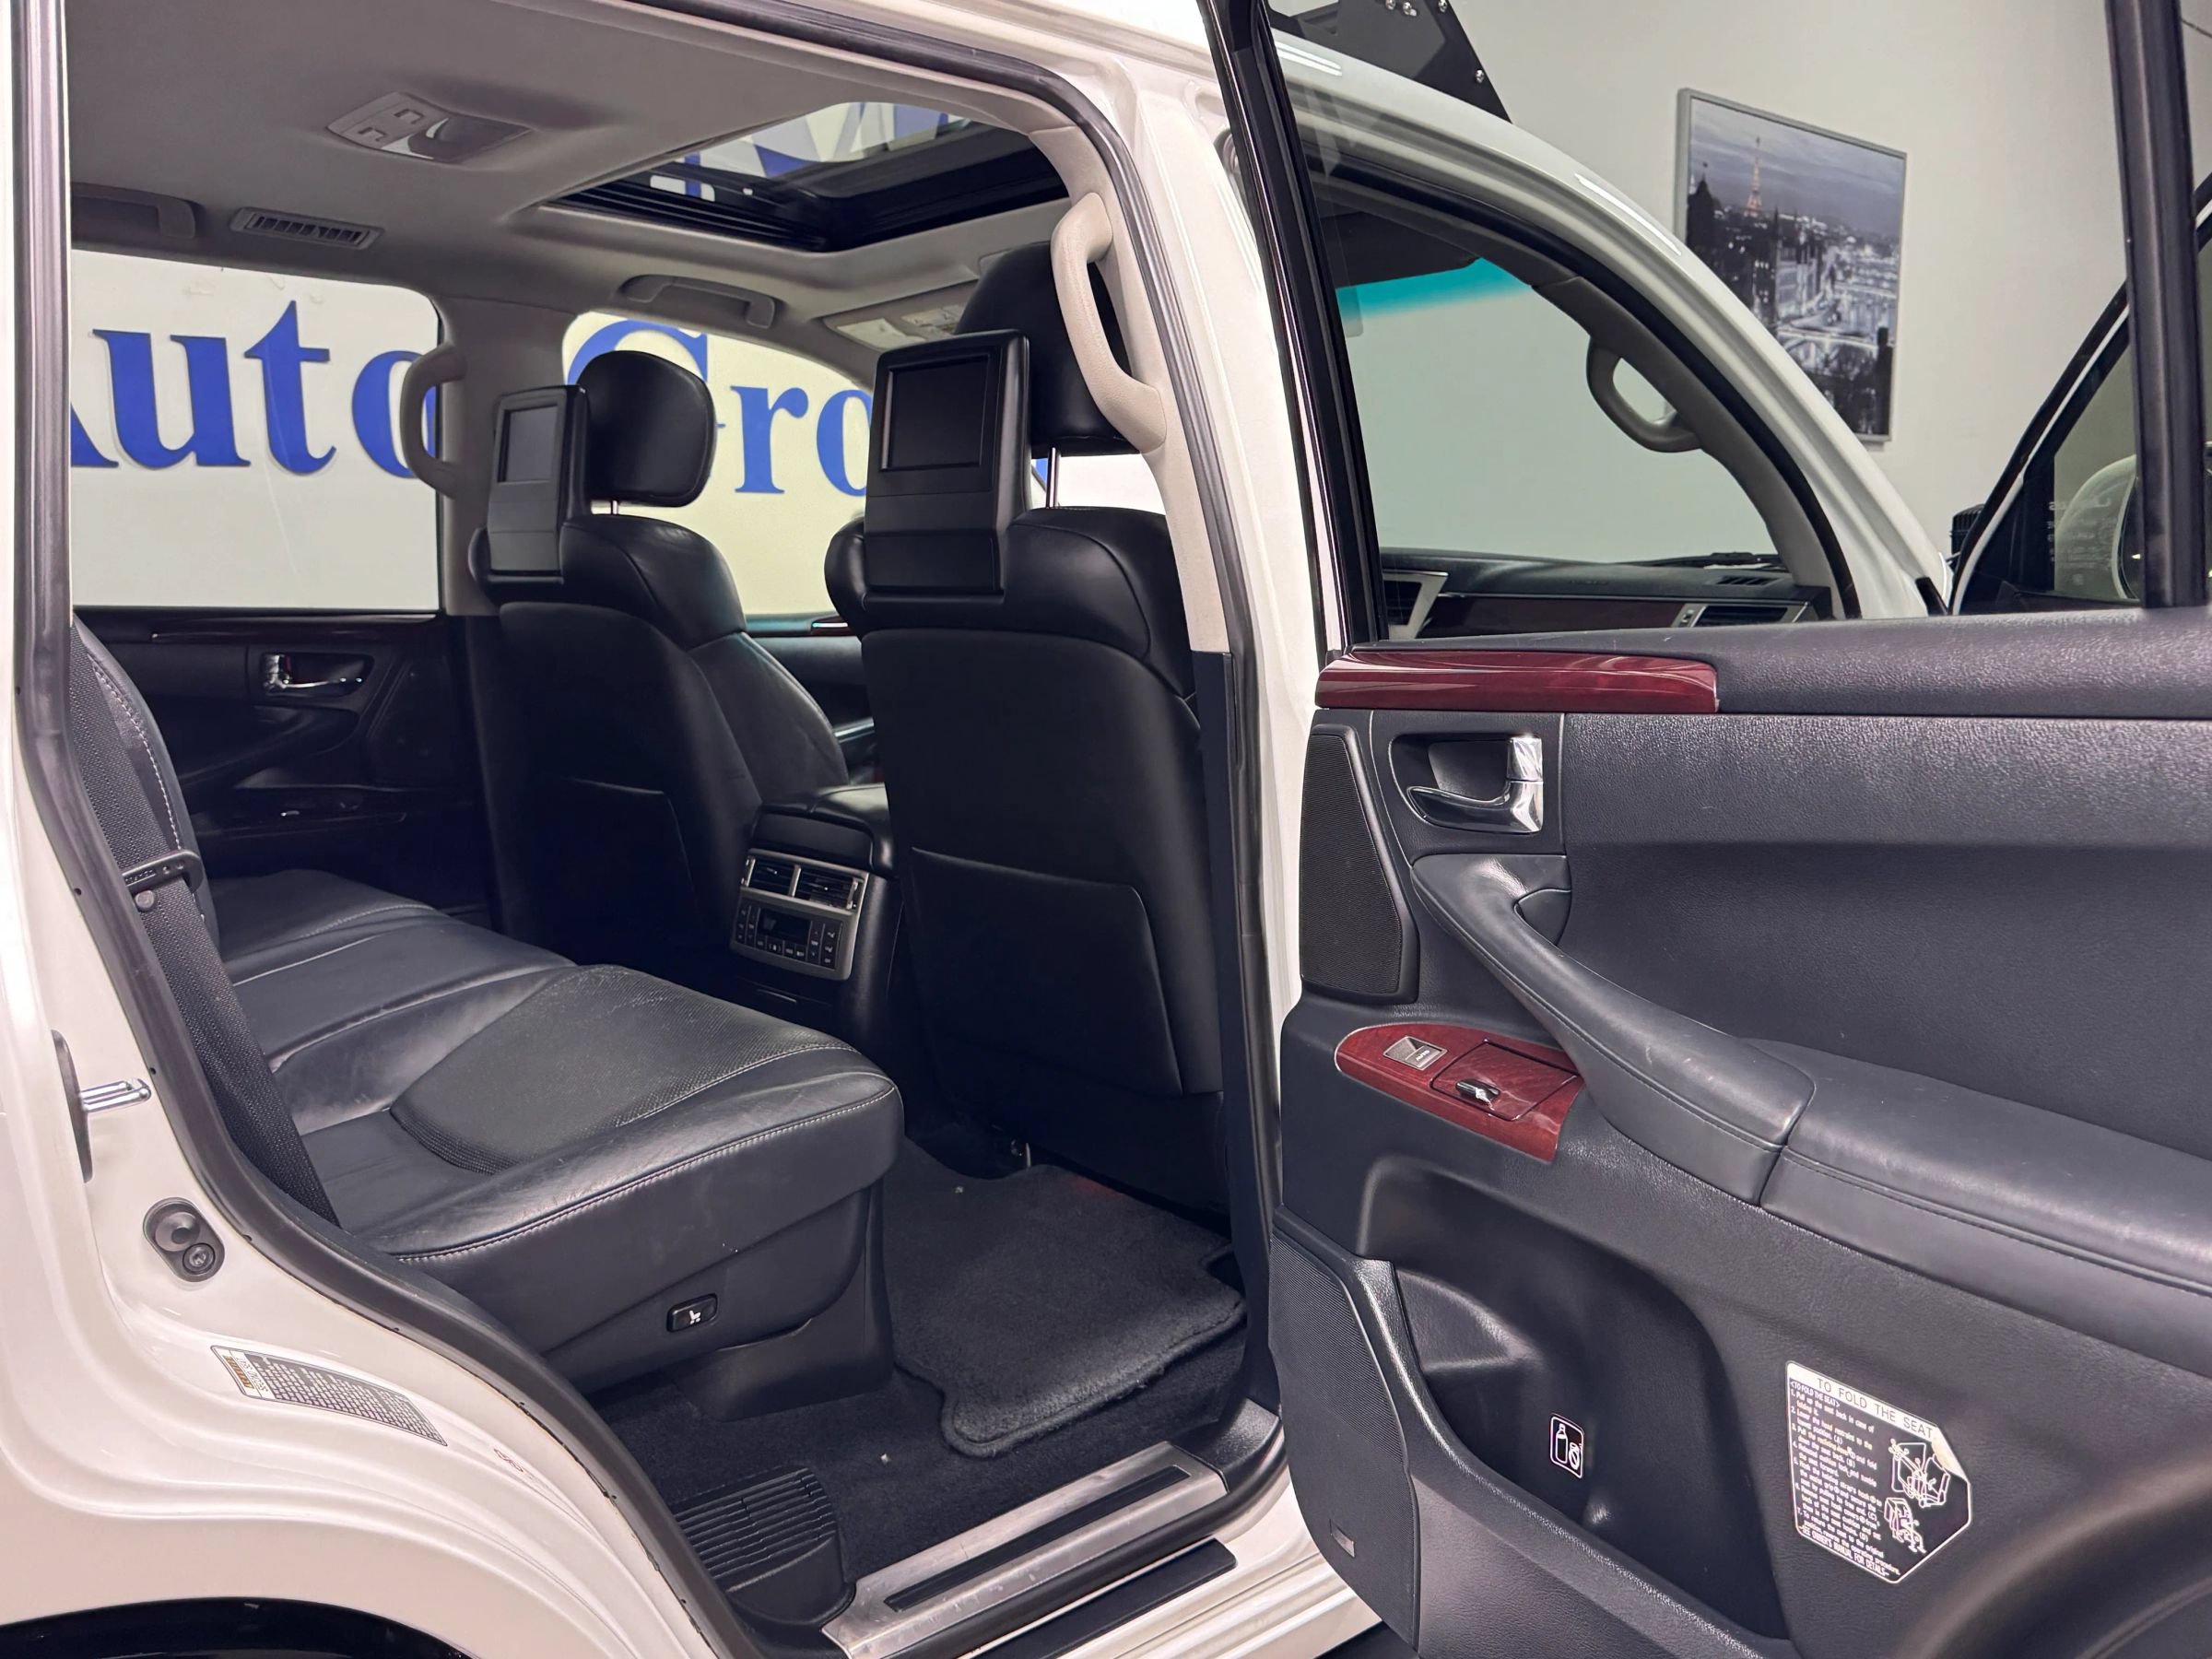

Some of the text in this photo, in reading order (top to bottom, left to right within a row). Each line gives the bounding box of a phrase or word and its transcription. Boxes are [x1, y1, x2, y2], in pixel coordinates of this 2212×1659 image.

[1818, 1379, 1932, 1439] TO FOLD THE SEAT
